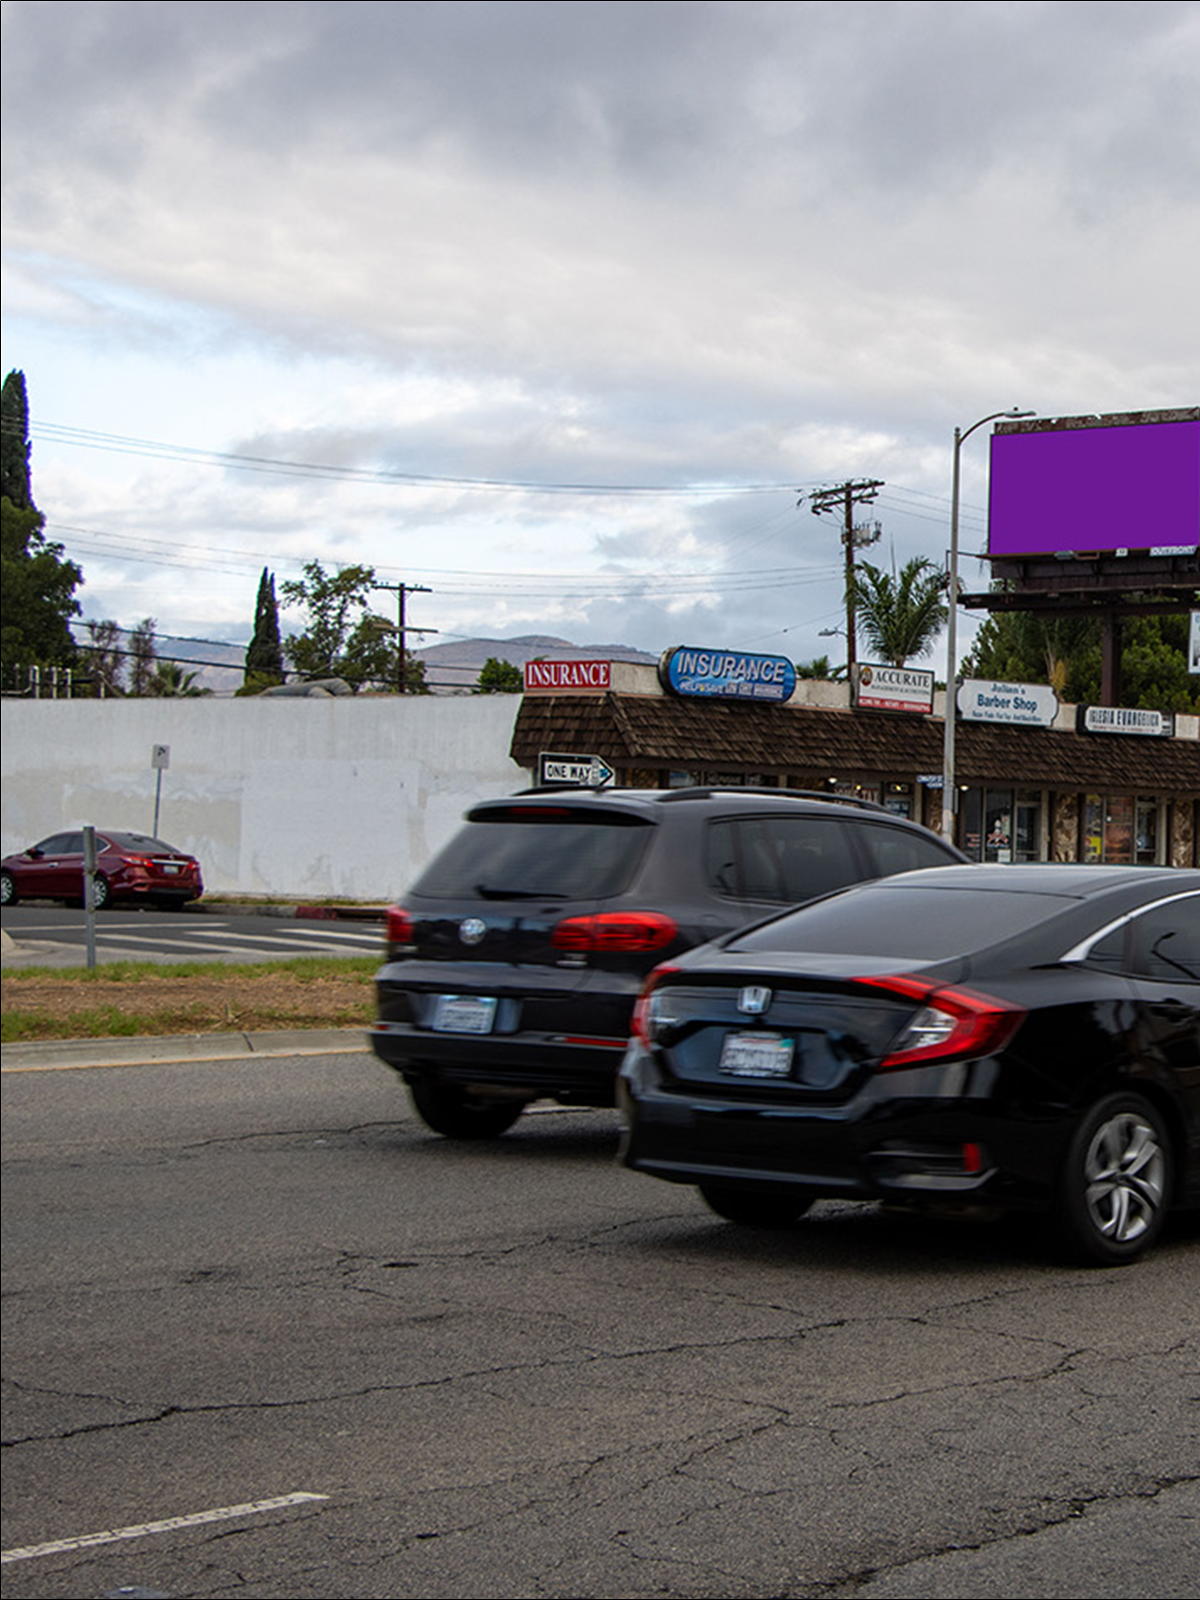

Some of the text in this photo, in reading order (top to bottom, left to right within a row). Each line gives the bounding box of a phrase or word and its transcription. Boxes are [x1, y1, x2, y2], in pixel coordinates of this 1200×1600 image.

[528, 663, 609, 686] INSURANCE
[677, 652, 787, 684] INSURANCE
[874, 670, 930, 688] ACCURATE
[978, 694, 1038, 714] Barber Shop
[1090, 709, 1115, 725] IGLESIA
[548, 765, 591, 779] ONE WAY
